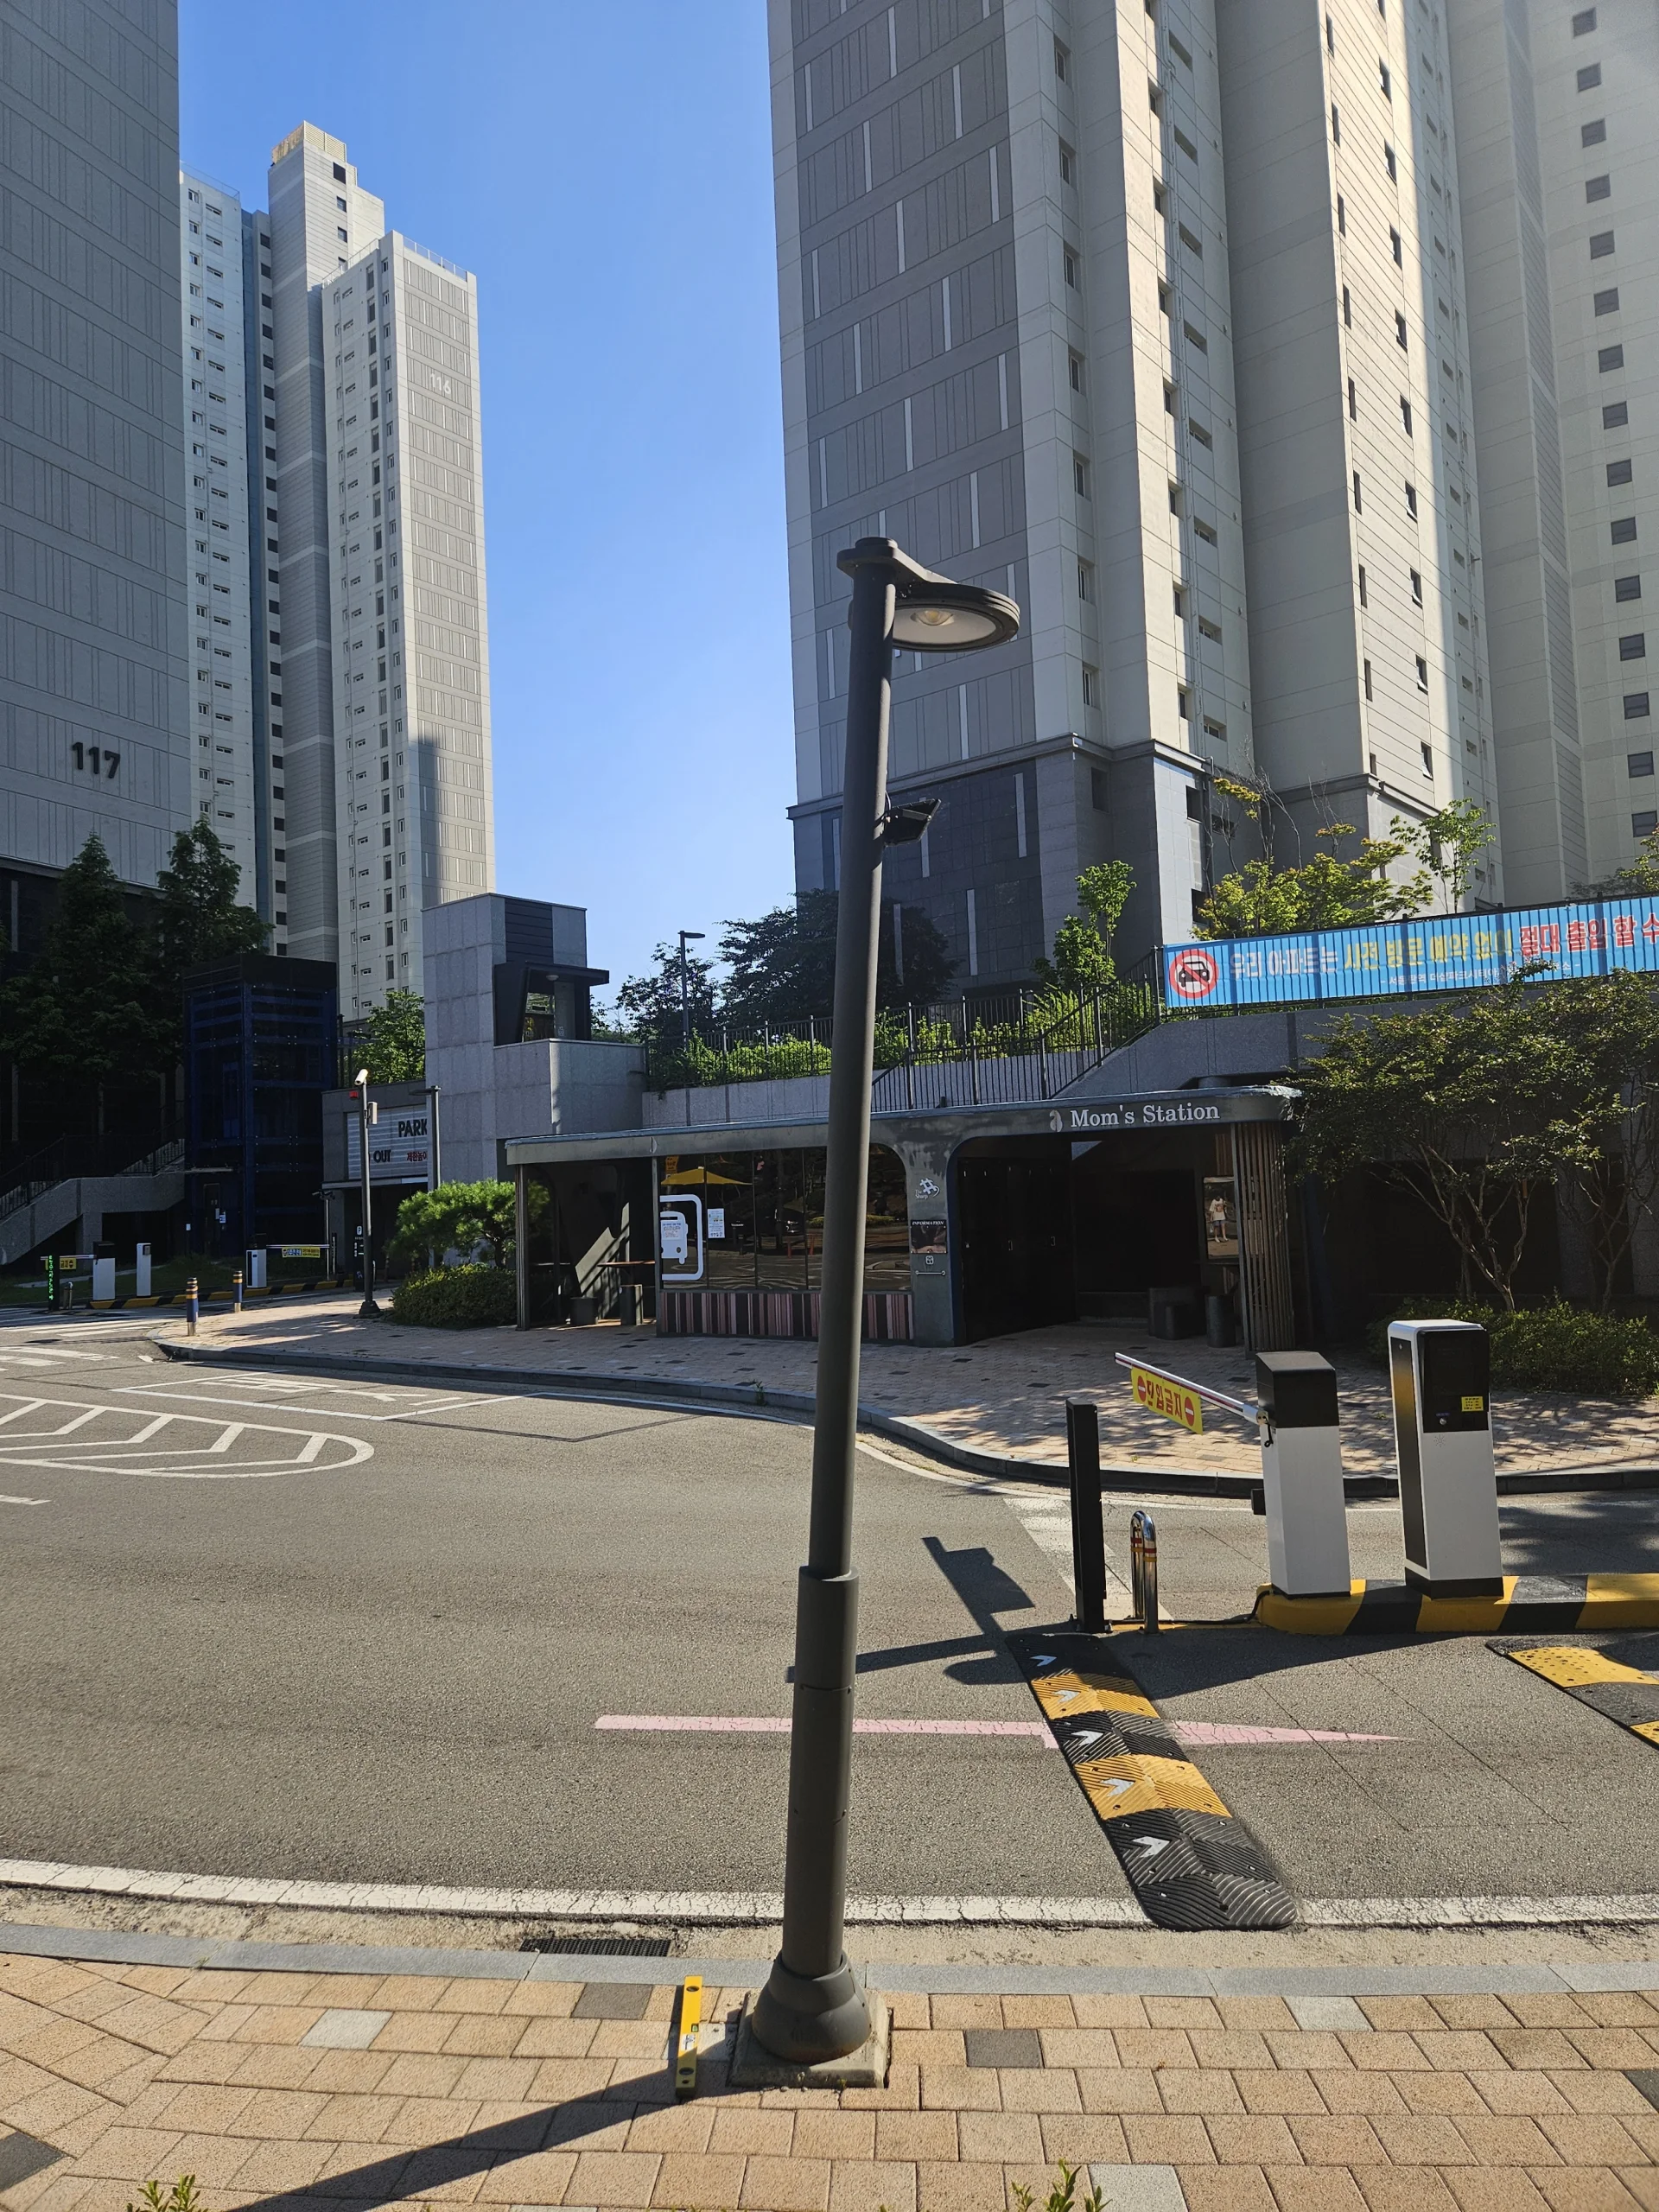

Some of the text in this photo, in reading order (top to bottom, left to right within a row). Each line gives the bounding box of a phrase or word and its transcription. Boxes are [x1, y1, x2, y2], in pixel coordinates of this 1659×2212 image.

[430, 372, 451, 395] 116
[72, 741, 121, 779] 117
[1230, 912, 1659, 979] 우리 아파트는 사전 방문 예약 없이 절대 출입 할 수
[1070, 1102, 1221, 1128] Mom's Station
[372, 1149, 392, 1163] OUT
